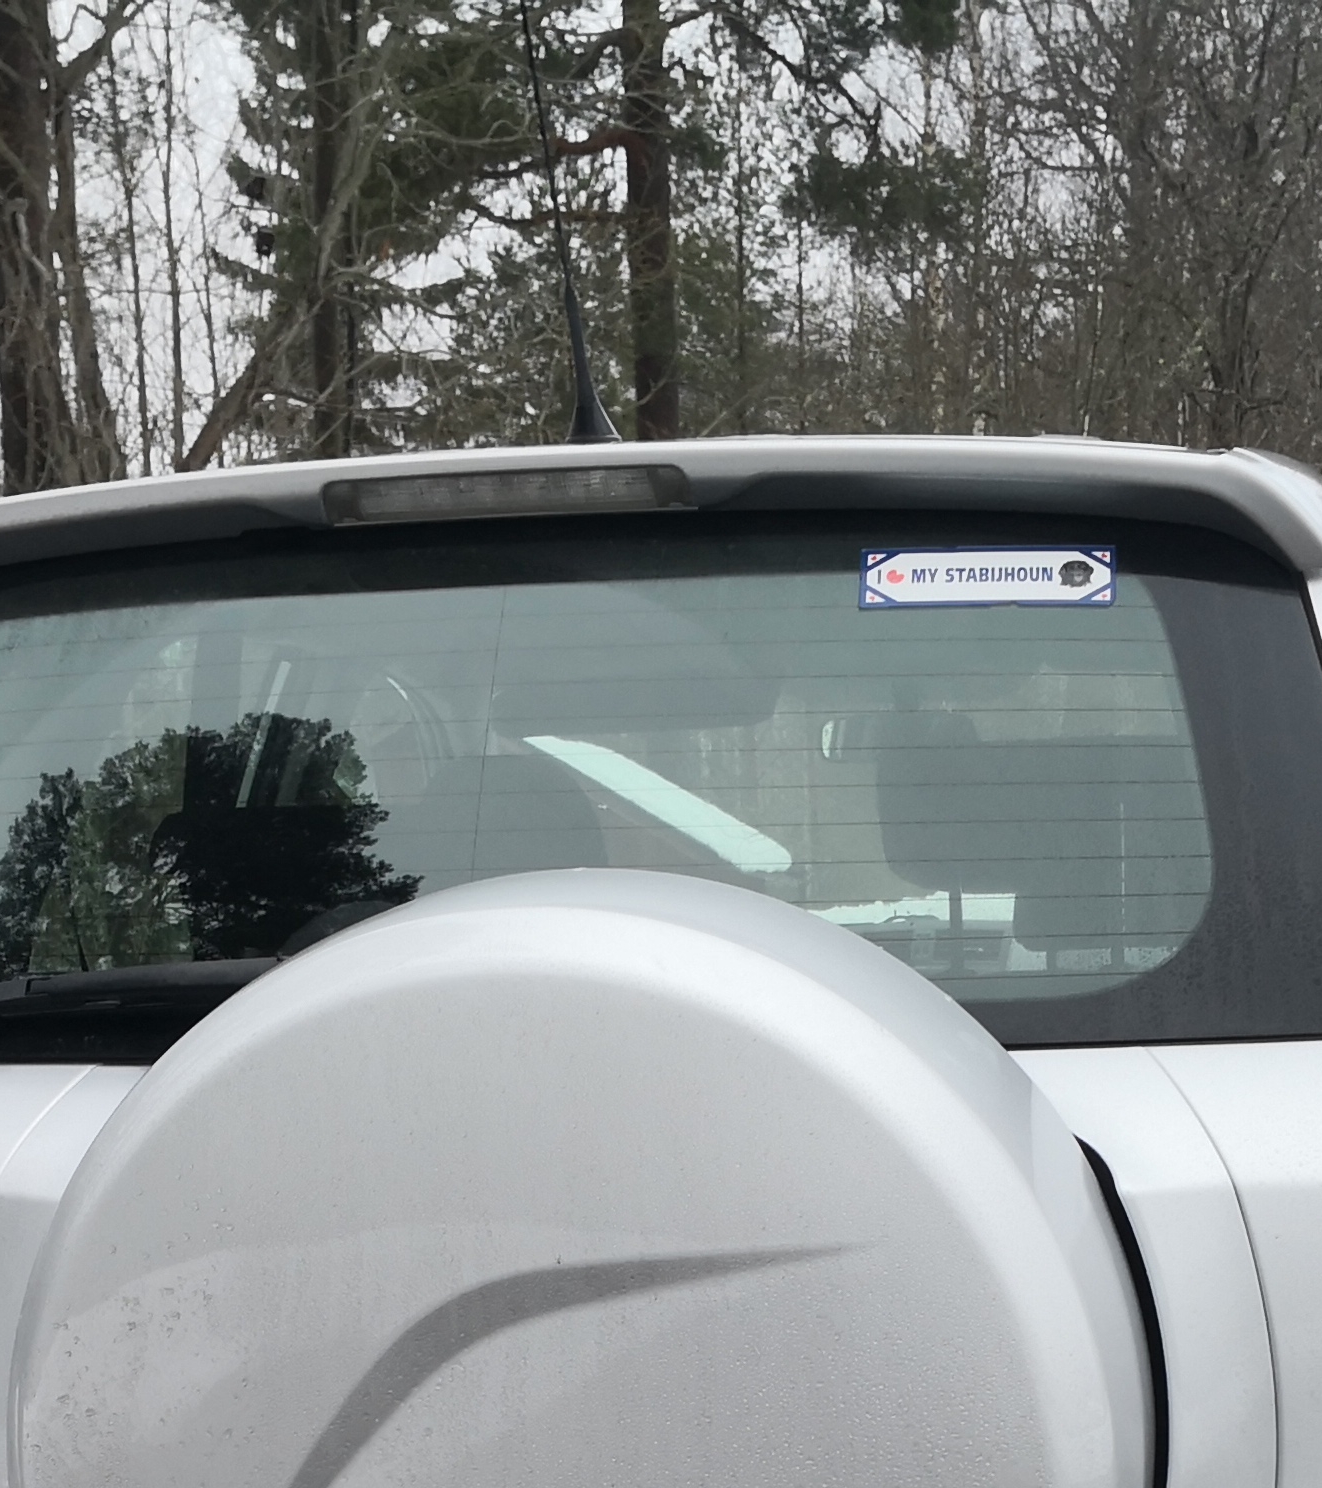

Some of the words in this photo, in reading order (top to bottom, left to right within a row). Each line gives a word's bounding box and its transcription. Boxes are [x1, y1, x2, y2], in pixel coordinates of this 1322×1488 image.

[877, 570, 882, 584] I
[911, 568, 939, 584] MY
[945, 567, 1053, 583] STABIJHOUN
